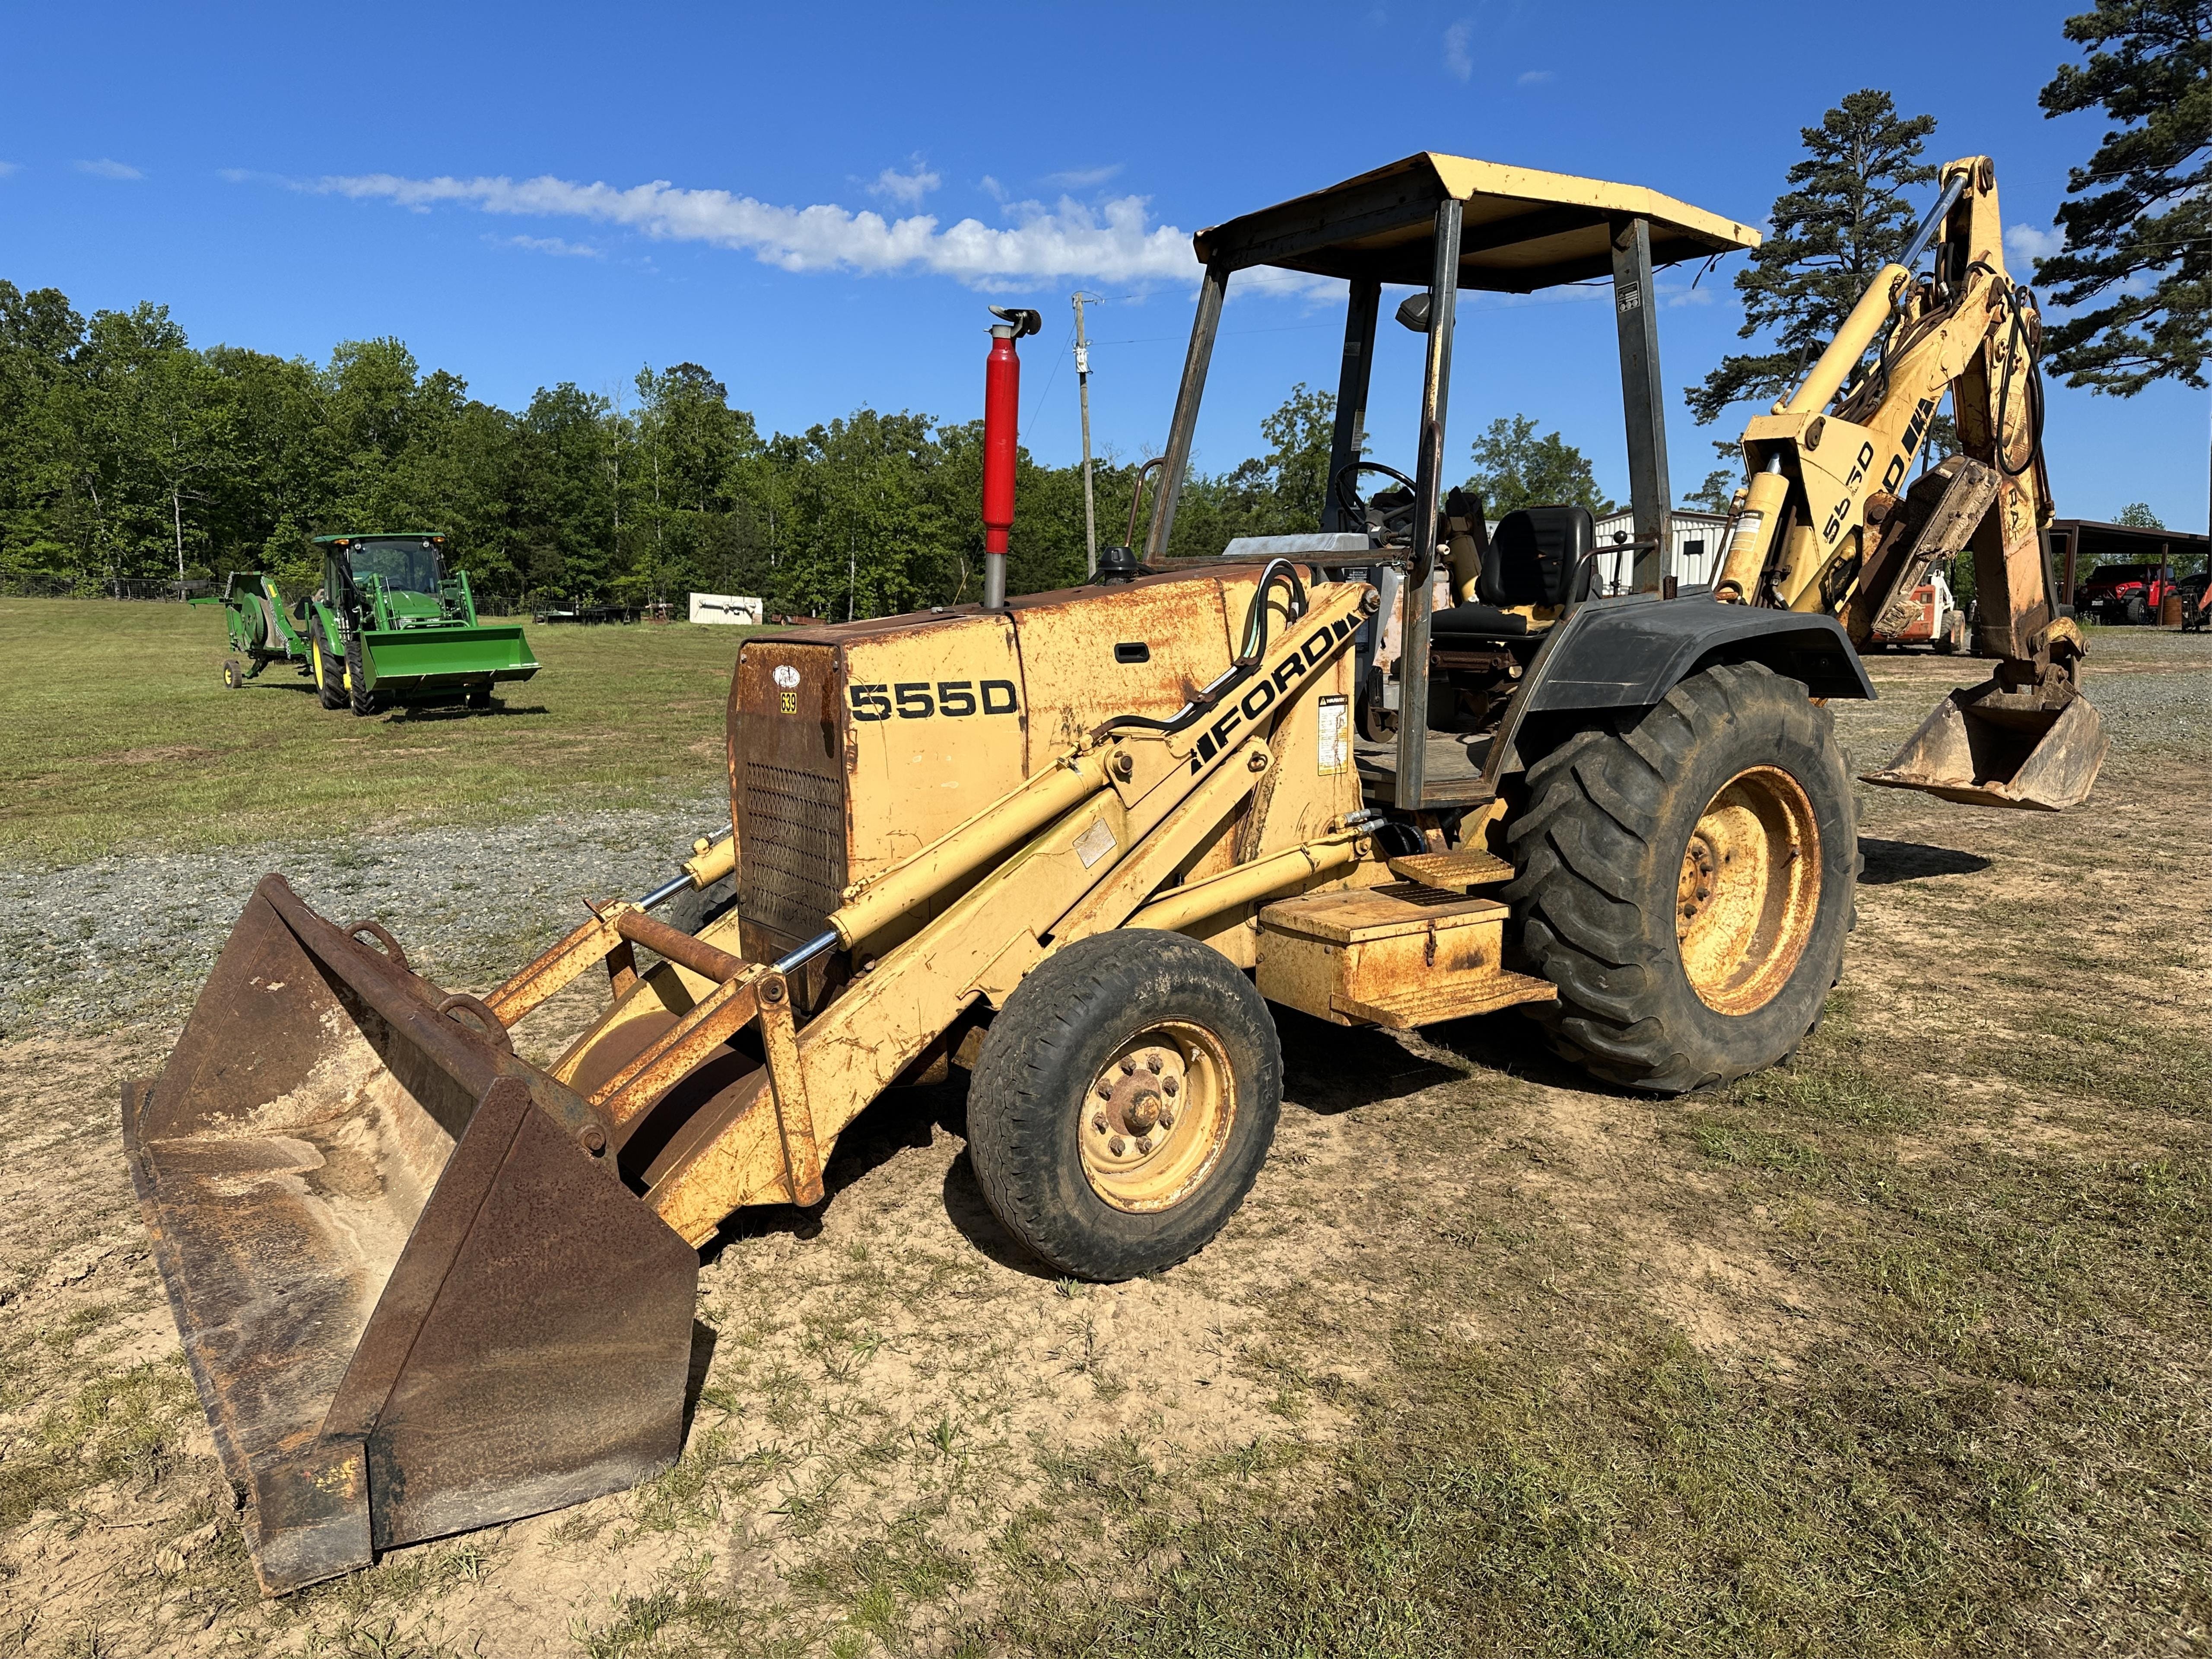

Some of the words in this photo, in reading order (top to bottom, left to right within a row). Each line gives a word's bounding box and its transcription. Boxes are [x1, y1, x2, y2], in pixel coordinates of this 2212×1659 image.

[781, 693, 796, 712] 639
[849, 680, 1017, 721] 555D
[1210, 626, 1334, 749] FORD
